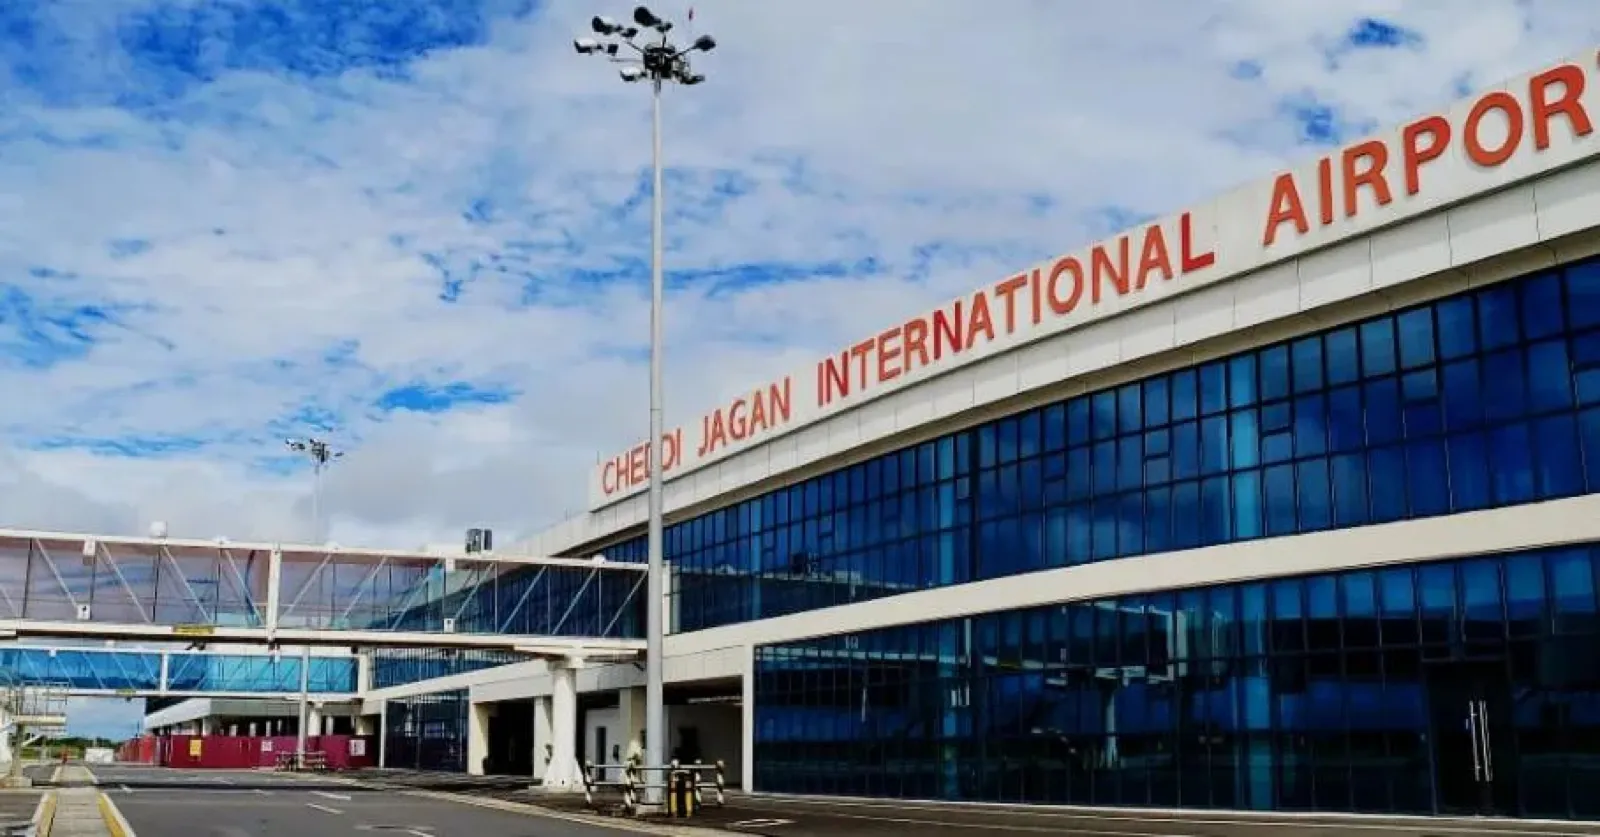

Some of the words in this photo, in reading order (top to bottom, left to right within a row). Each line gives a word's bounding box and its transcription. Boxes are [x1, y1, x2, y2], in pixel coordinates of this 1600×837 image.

[698, 376, 791, 457] JAGAN
[817, 212, 1216, 407] INTERNATIONAL
[1262, 50, 1600, 247] AIRPOR
